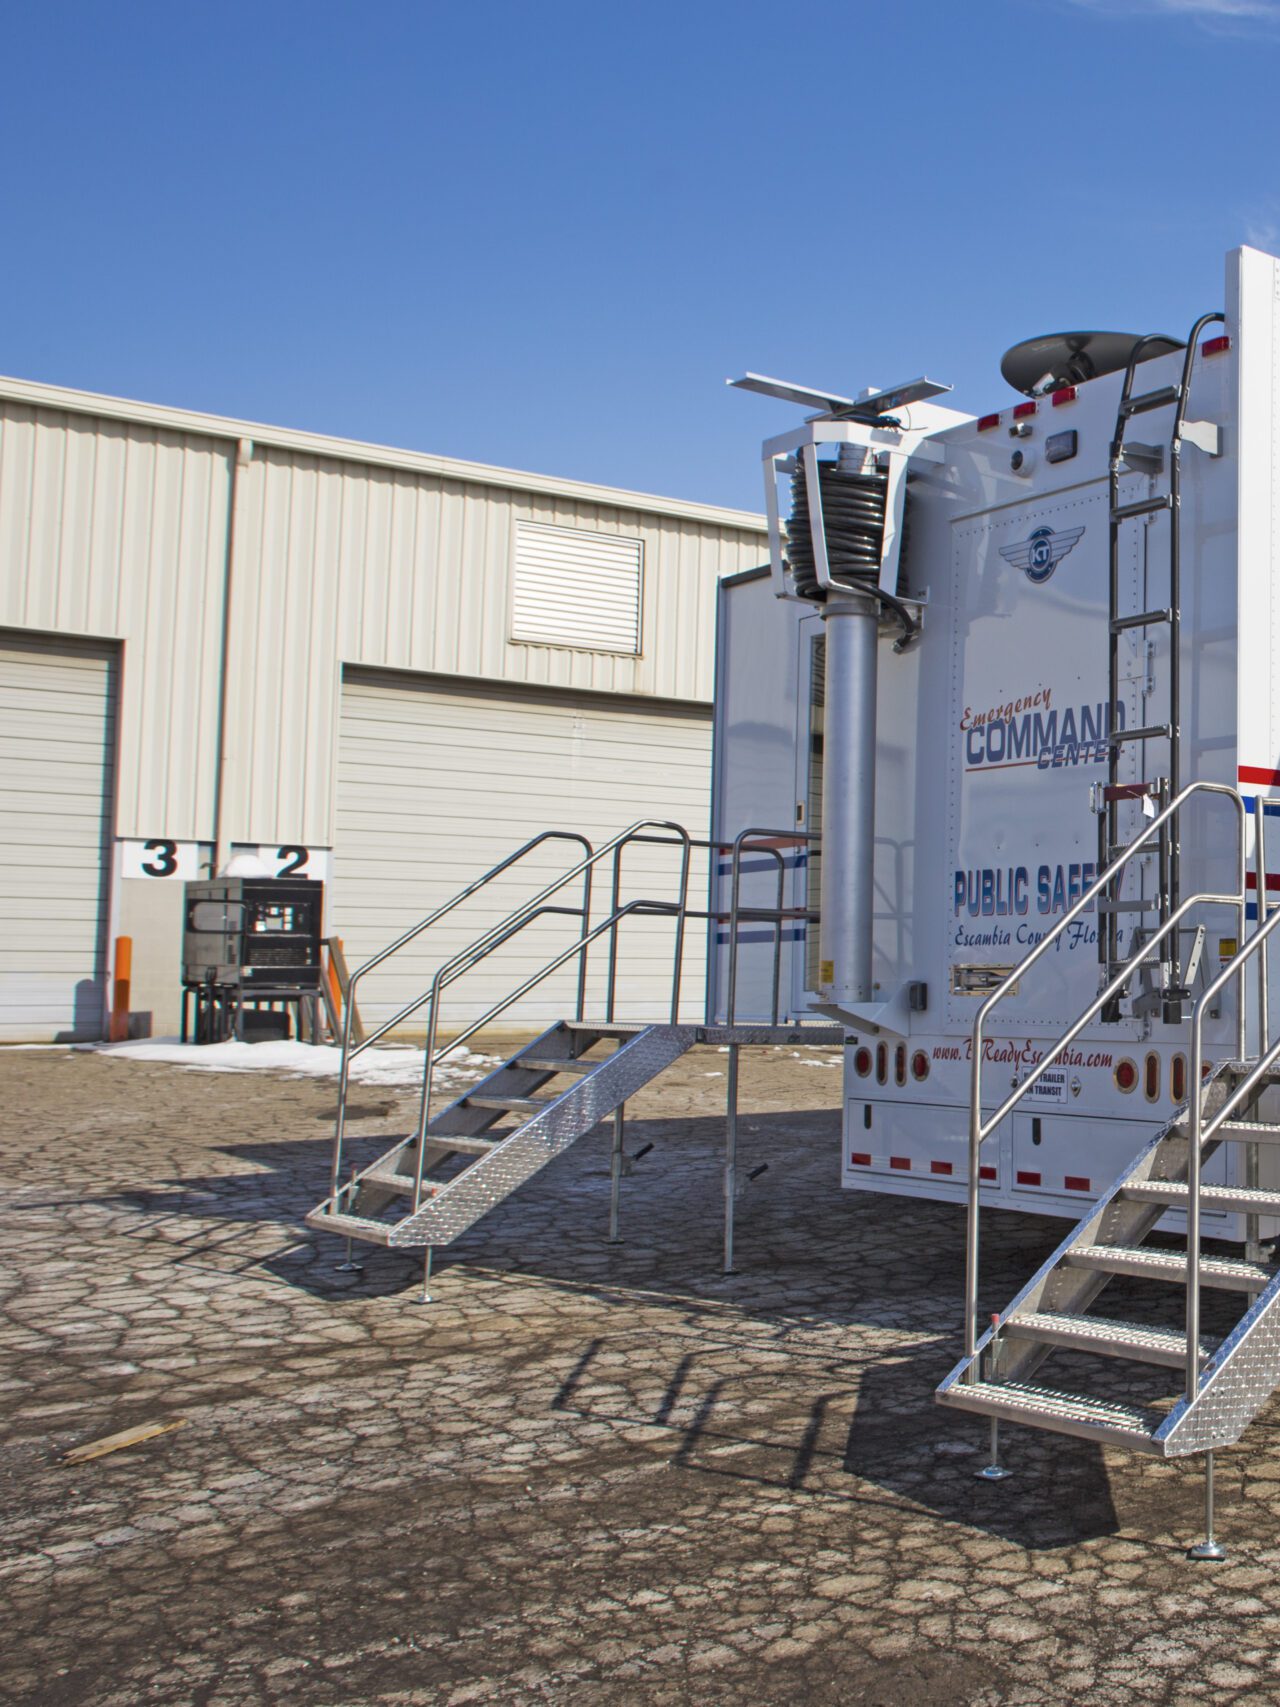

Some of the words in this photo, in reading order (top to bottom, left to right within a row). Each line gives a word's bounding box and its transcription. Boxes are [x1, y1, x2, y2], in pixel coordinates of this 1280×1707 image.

[1031, 546, 1049, 563] KT
[960, 688, 1052, 731] Emergency
[966, 700, 1126, 765] COMMAND
[141, 838, 178, 877] 3
[276, 844, 310, 879] 2
[954, 866, 1029, 917] PUBLIC
[1037, 862, 1126, 915] SAFE
[955, 925, 1011, 947] Escambia
[1035, 1085, 1062, 1096] TRANSIT
[1040, 1073, 1065, 1084] TRAILER
